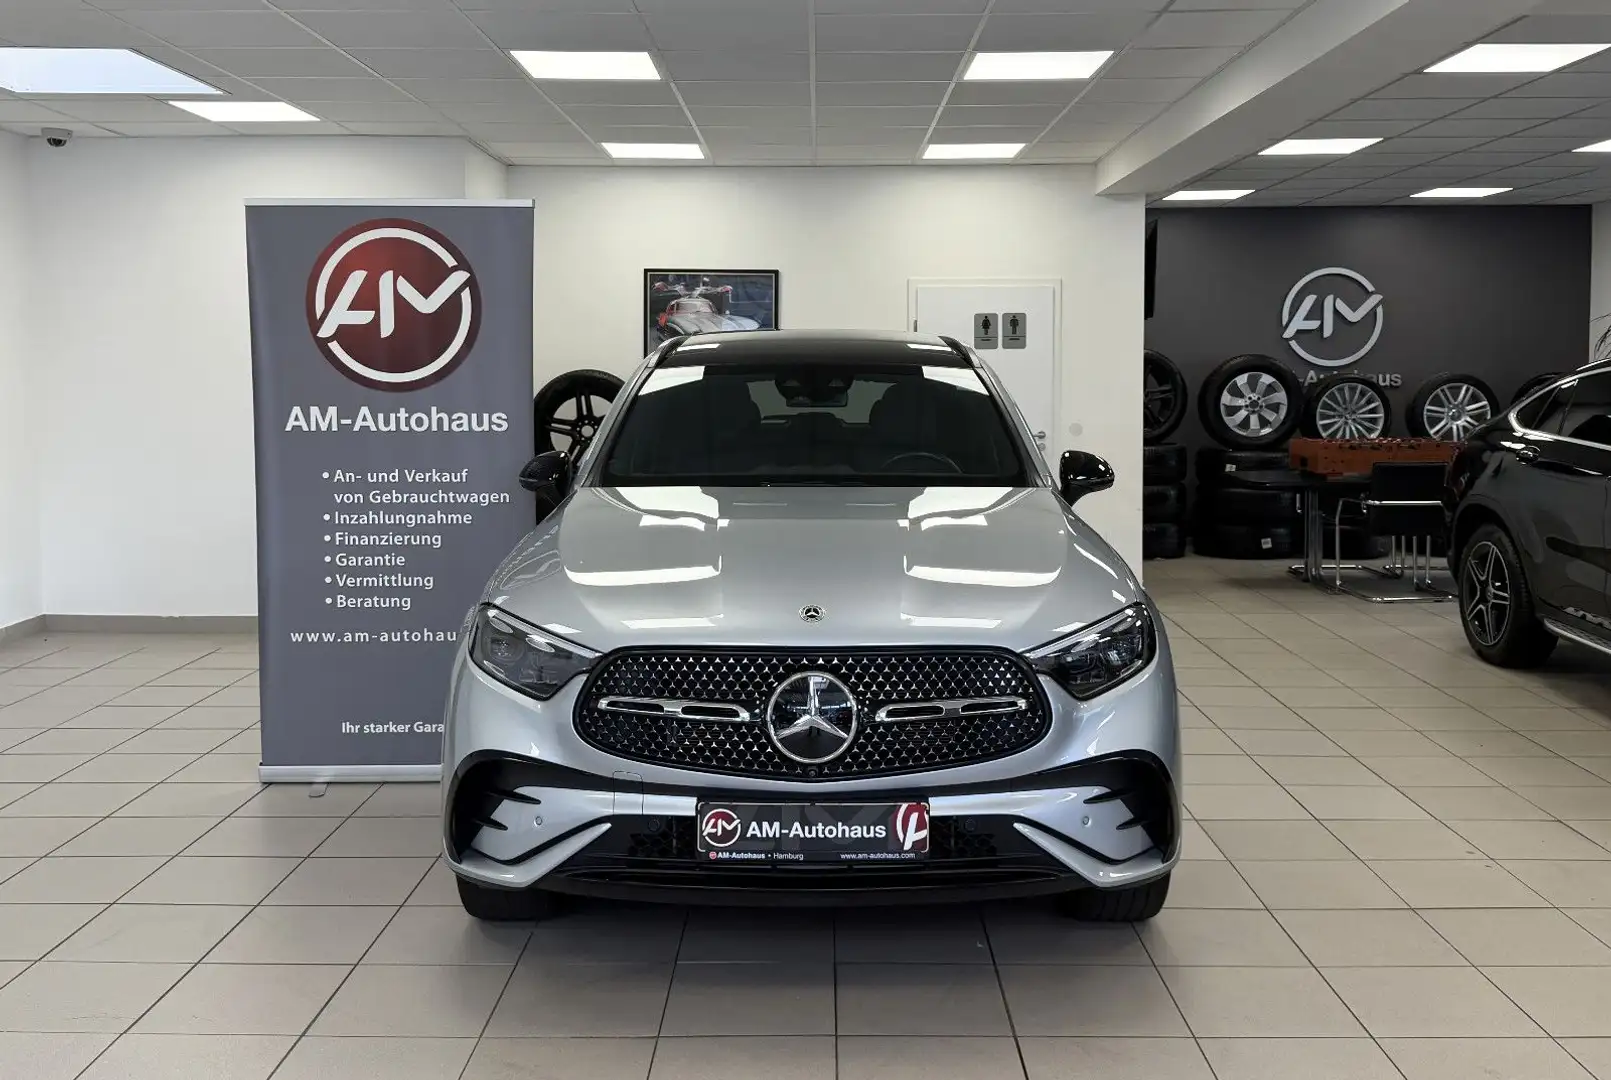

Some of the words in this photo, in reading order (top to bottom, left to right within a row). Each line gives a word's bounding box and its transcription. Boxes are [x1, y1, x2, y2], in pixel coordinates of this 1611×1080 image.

[284, 405, 509, 432] AM-Autohaus
[333, 469, 362, 483] An-
[367, 469, 399, 483] und
[405, 469, 469, 483] Verkauf
[333, 493, 364, 504] von
[369, 490, 510, 506] Gebrauchtwagen
[335, 511, 473, 525] Inzahlungnahme
[335, 532, 442, 548] Finanzierung
[335, 553, 406, 567] Garantie
[336, 574, 434, 589] Vermittlung
[336, 595, 411, 610] Beratung
[341, 722, 360, 733] Ihr
[363, 722, 411, 733] starker
[746, 821, 887, 839] AM-Autohaus
[717, 851, 766, 860] AM-Autohaus
[773, 852, 804, 861] Hamburg
[840, 852, 916, 860] www.am-autohaus.com
